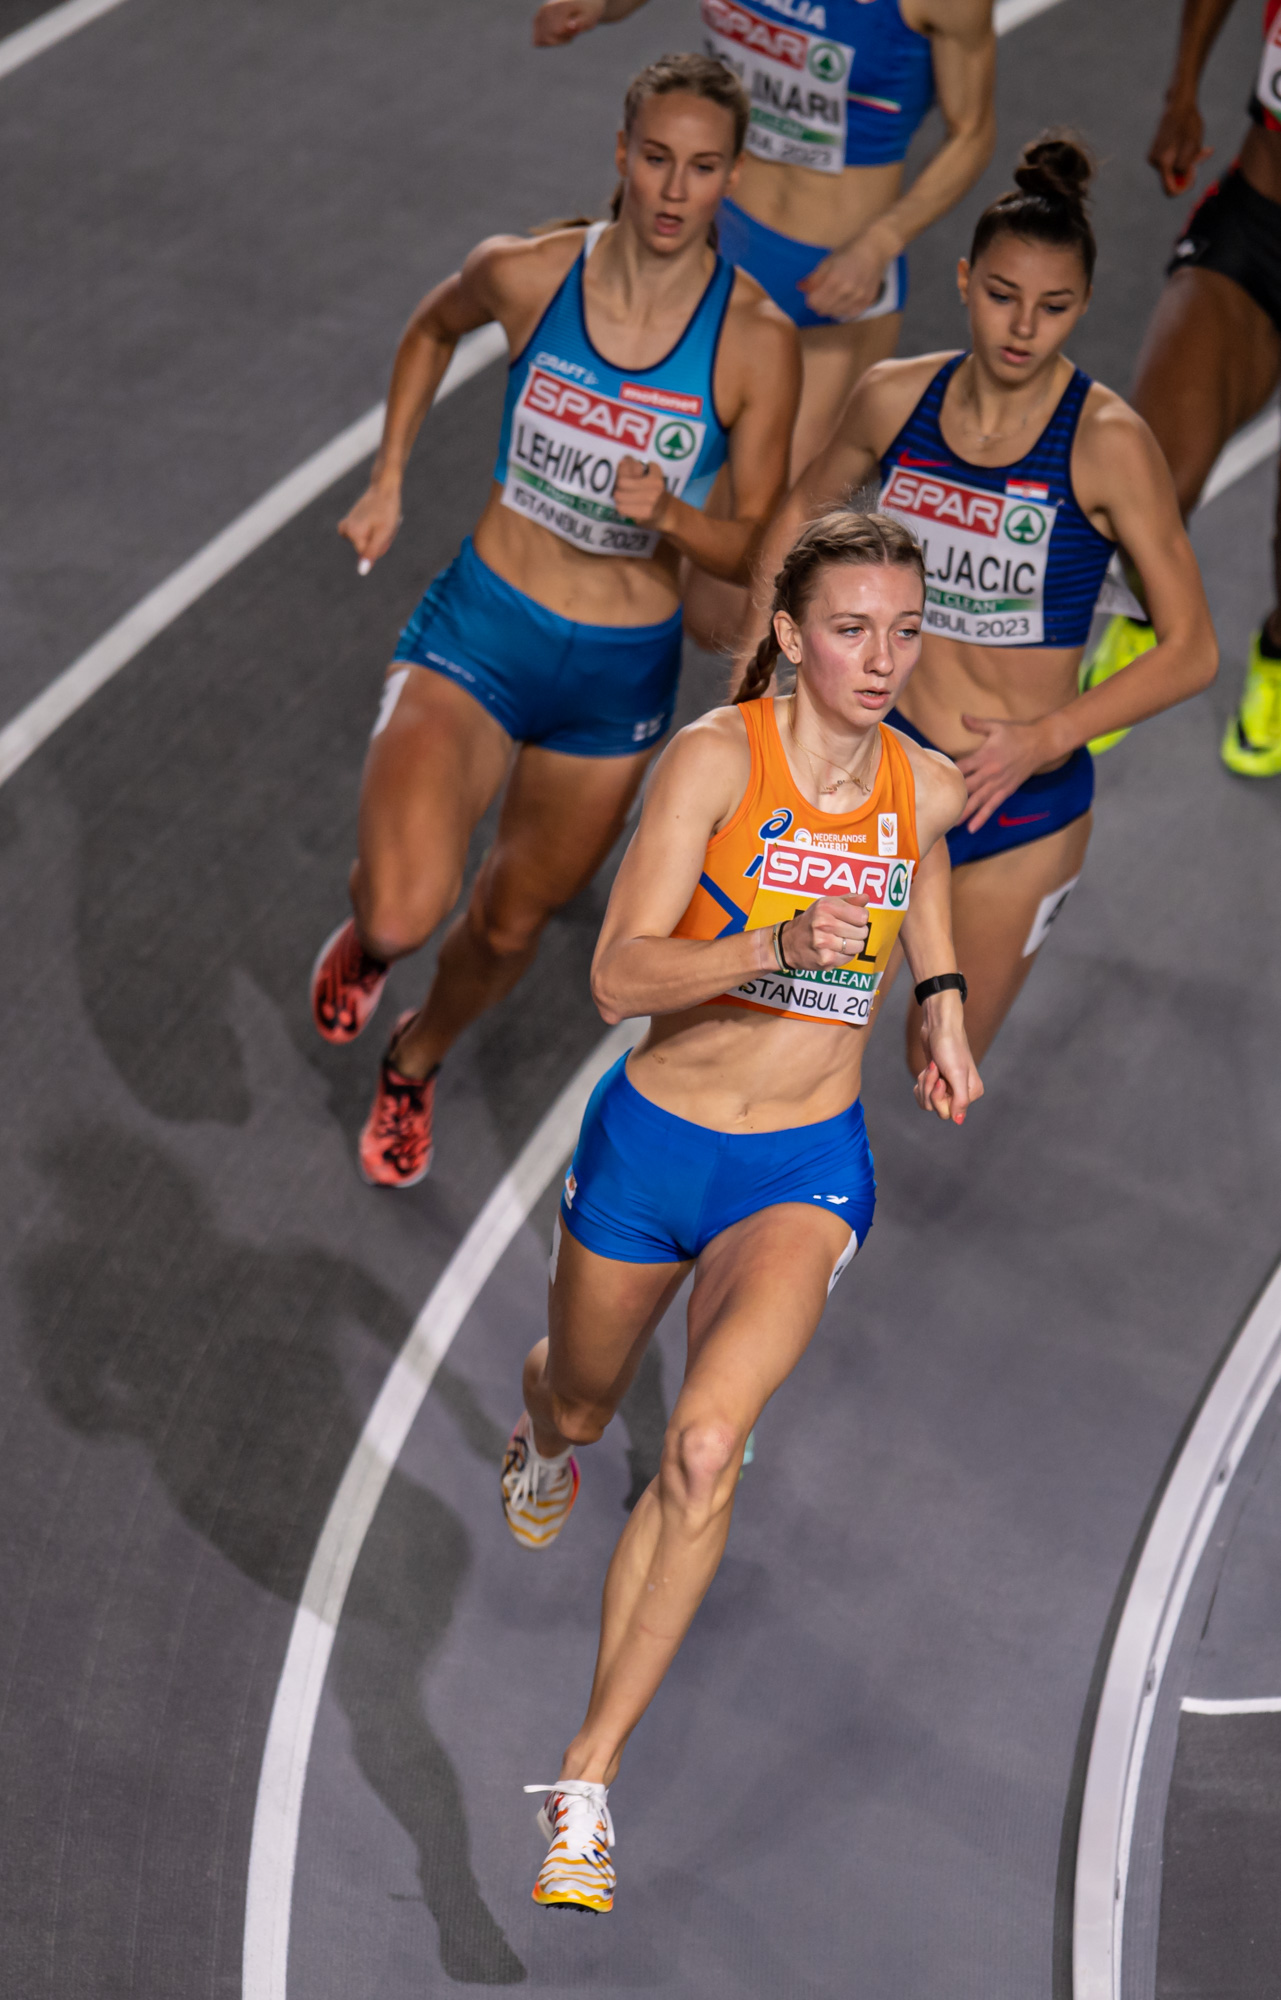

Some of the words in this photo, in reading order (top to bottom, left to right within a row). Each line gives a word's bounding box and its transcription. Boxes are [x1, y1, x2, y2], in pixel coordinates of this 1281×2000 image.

[529, 377, 650, 447] SPAR
[516, 423, 680, 498] LEHIKO
[514, 486, 593, 544] ISTANBUL
[600, 527, 650, 552] 2023
[889, 478, 999, 532] SPAR
[922, 538, 1036, 596] LJACIC
[925, 609, 971, 636] NBUL
[976, 617, 1030, 638] 2023
[944, 593, 997, 615] CLEAN
[813, 832, 867, 844] NEDERLANDSE
[767, 851, 886, 898] SPAR
[738, 978, 839, 1013] STANBUL
[843, 996, 872, 1018] 20
[821, 969, 872, 989] CLEAN
